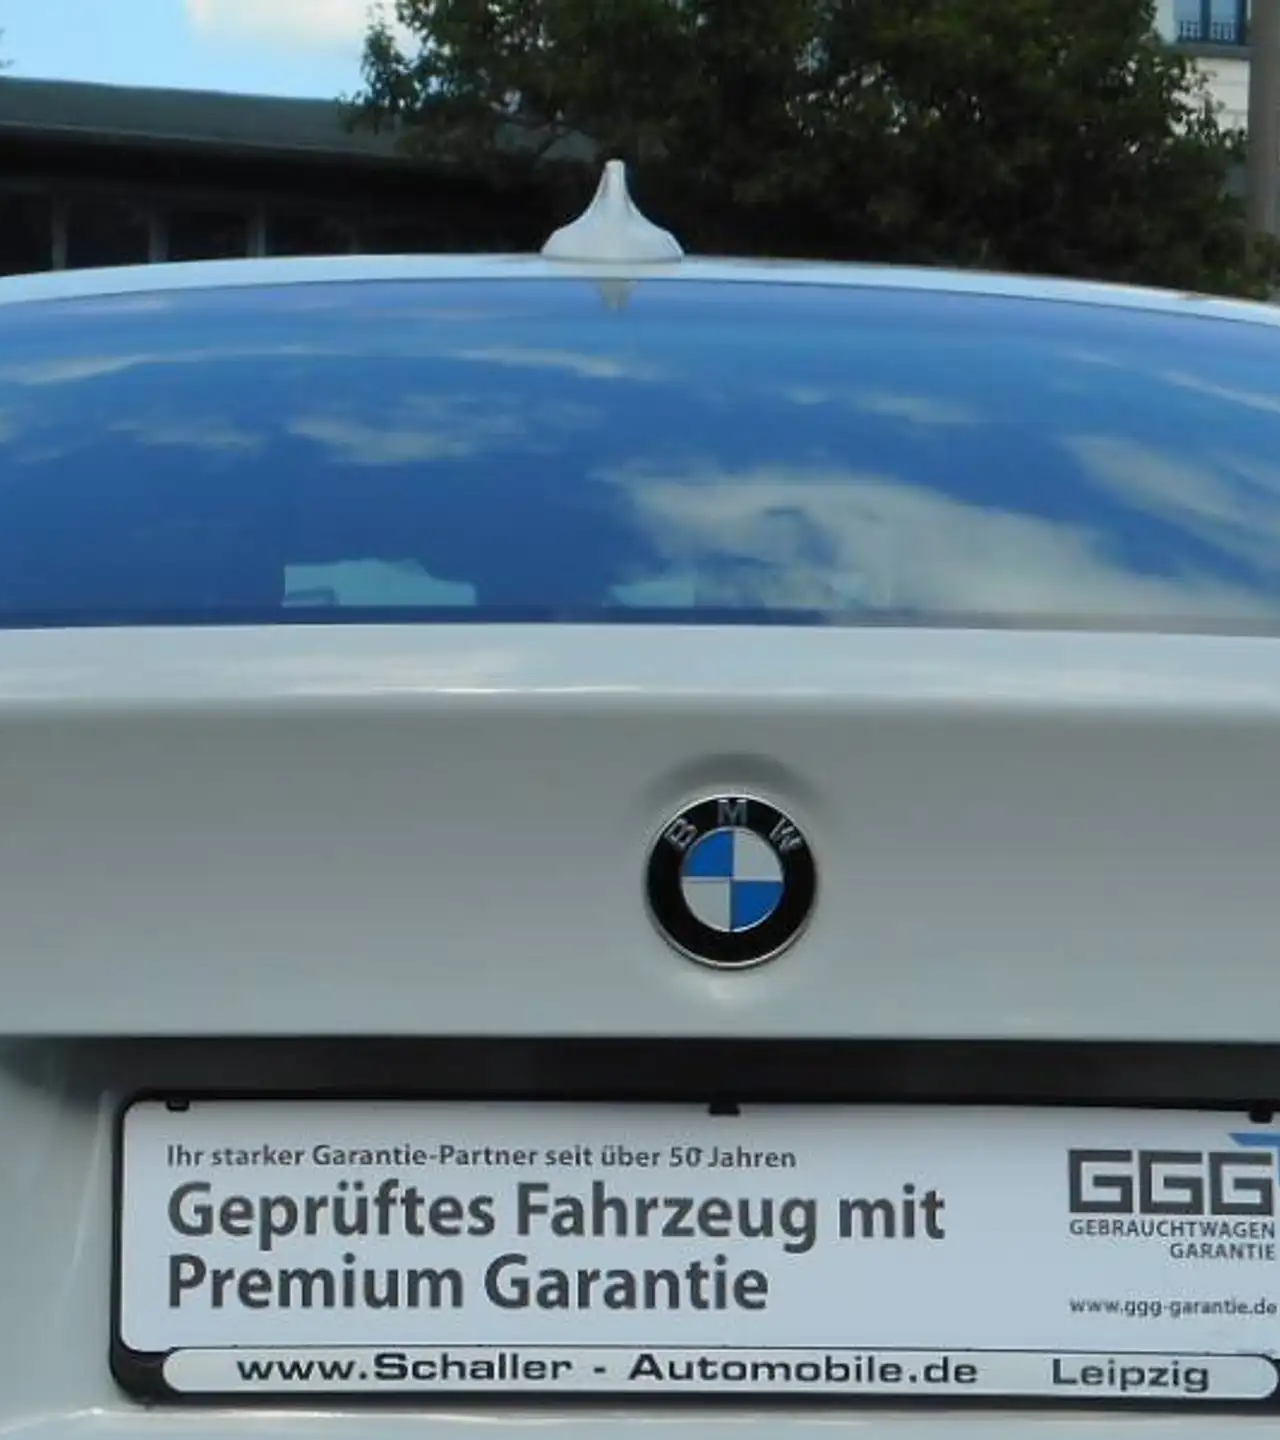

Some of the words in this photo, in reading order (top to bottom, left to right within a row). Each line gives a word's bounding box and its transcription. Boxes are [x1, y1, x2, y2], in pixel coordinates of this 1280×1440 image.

[663, 799, 803, 851] BMW
[167, 1144, 205, 1167] Ihr
[211, 1143, 306, 1166] starker
[311, 1143, 539, 1166] Garantie-Partner
[544, 1144, 593, 1167] seit
[600, 1144, 661, 1168] über
[669, 1146, 704, 1168] 50
[707, 1145, 797, 1168] Jahren
[1067, 1148, 1274, 1217] GGG
[167, 1177, 496, 1252] Geprüftes
[516, 1179, 817, 1253] Fahrzeug
[839, 1182, 946, 1240] mit
[1069, 1219, 1276, 1240] GEBRAUCHTWAGEN
[1169, 1242, 1275, 1261] GARANTIE
[169, 1252, 463, 1309] Premium
[484, 1253, 769, 1310] Garantie
[1069, 1297, 1278, 1319] www.ggg-garantie.de
[236, 1352, 573, 1381] www.Schaller
[627, 1352, 978, 1384] Automobile.de
[1051, 1356, 1210, 1392] Leipzig
